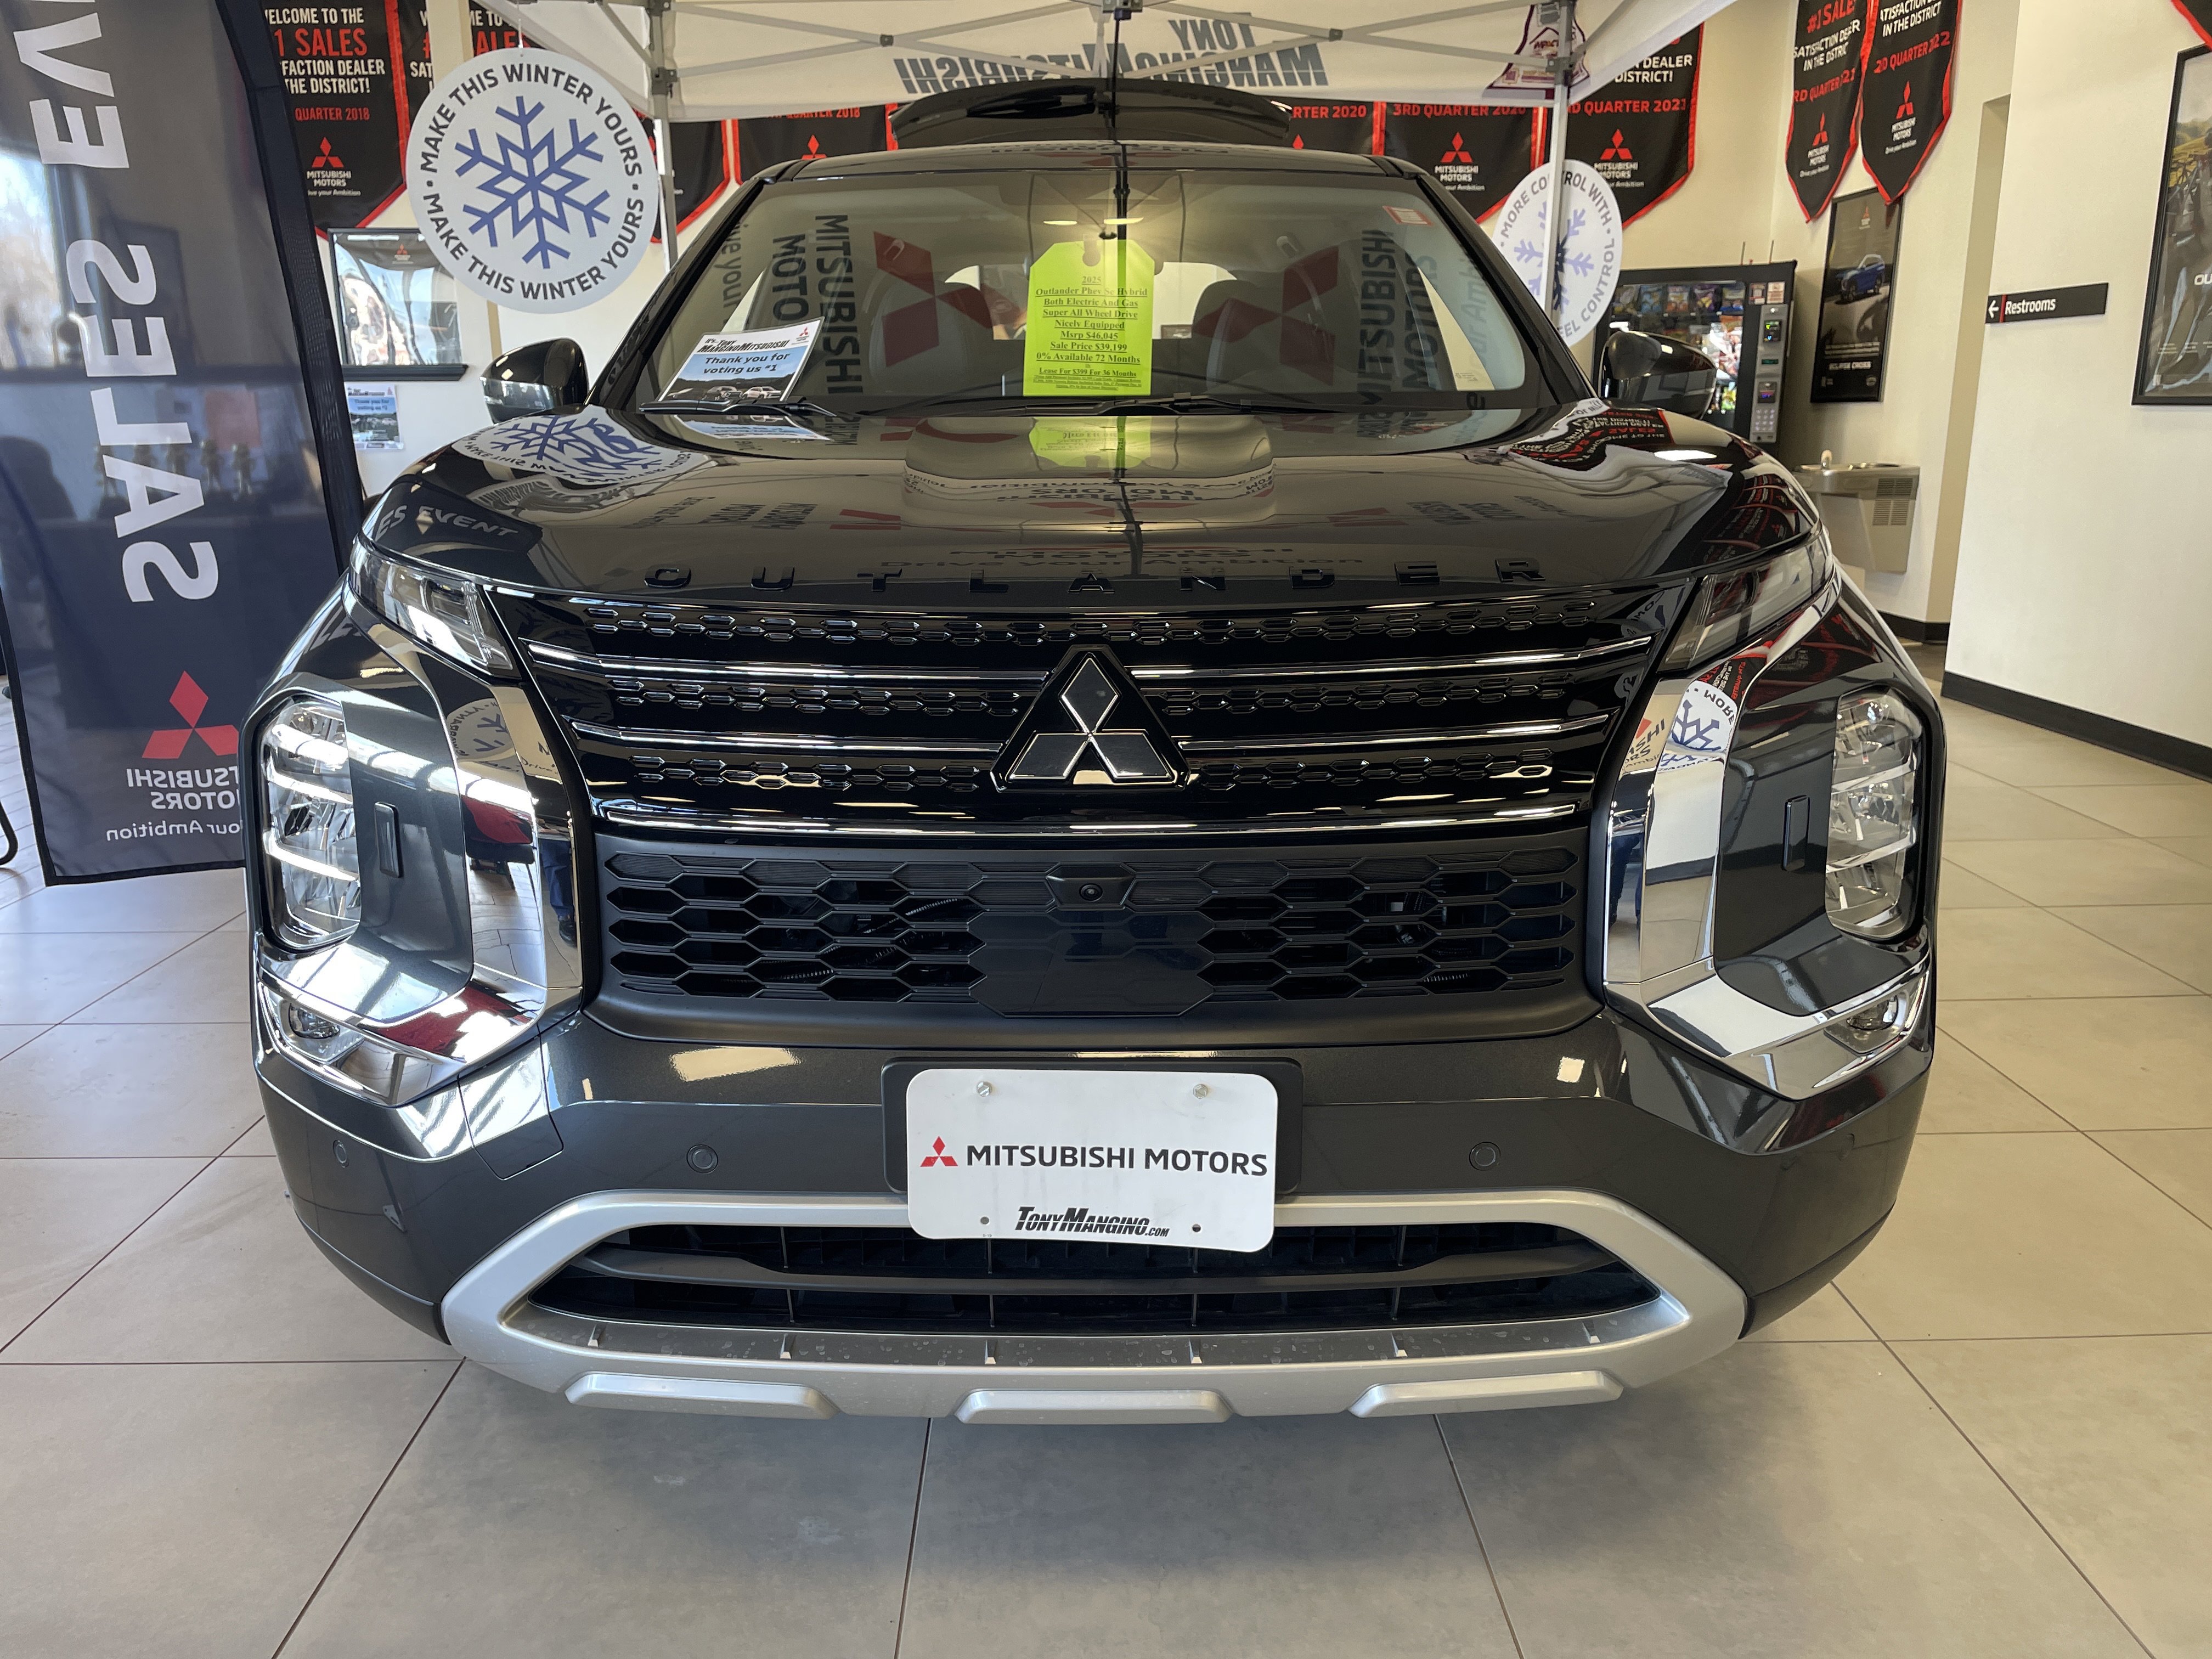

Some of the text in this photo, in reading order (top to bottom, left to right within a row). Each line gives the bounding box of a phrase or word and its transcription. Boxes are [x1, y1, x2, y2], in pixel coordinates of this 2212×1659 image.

[265, 7, 365, 25] ELCOME TO THE
[1822, 0, 1856, 26] SALE
[1893, 16, 1910, 33] THE
[274, 27, 368, 57] 1 SALES
[280, 59, 385, 76] FACTION DEALER
[1642, 54, 1693, 69] DEALER
[309, 77, 370, 94] DISTRICT!
[295, 107, 370, 122] QUARTER 2018
[1332, 104, 1367, 118] 2020
[1392, 104, 1420, 116] 3RD
[1423, 104, 1489, 119] QUARTER
[1584, 100, 1650, 116] QUARTER
[1654, 98, 1687, 113] 2021
[421, 63, 642, 176] MAKE THIS WINTER YOURS
[1500, 171, 1612, 238] MORE COROL WITH
[423, 193, 644, 300] MAKE THIS WINTER YOURS
[772, 234, 809, 321] MOTO
[1581, 238, 1615, 323] CONTROL
[1036, 287, 1079, 296] Outlander
[1043, 309, 1068, 318] Super
[1115, 310, 1138, 318] Drive
[2004, 297, 2057, 315] Restrooms
[1055, 319, 1125, 329] Nicely Equipped
[1060, 330, 1084, 340] Msrp
[1071, 342, 1093, 350] Price
[1095, 343, 1127, 352] $39,199
[743, 356, 769, 364] you
[1053, 353, 1093, 362] Available
[1108, 354, 1141, 363] Months
[644, 557, 1546, 594] OUTLANDER
[966, 1144, 1268, 1176] MITSUBISHI MOTORS
